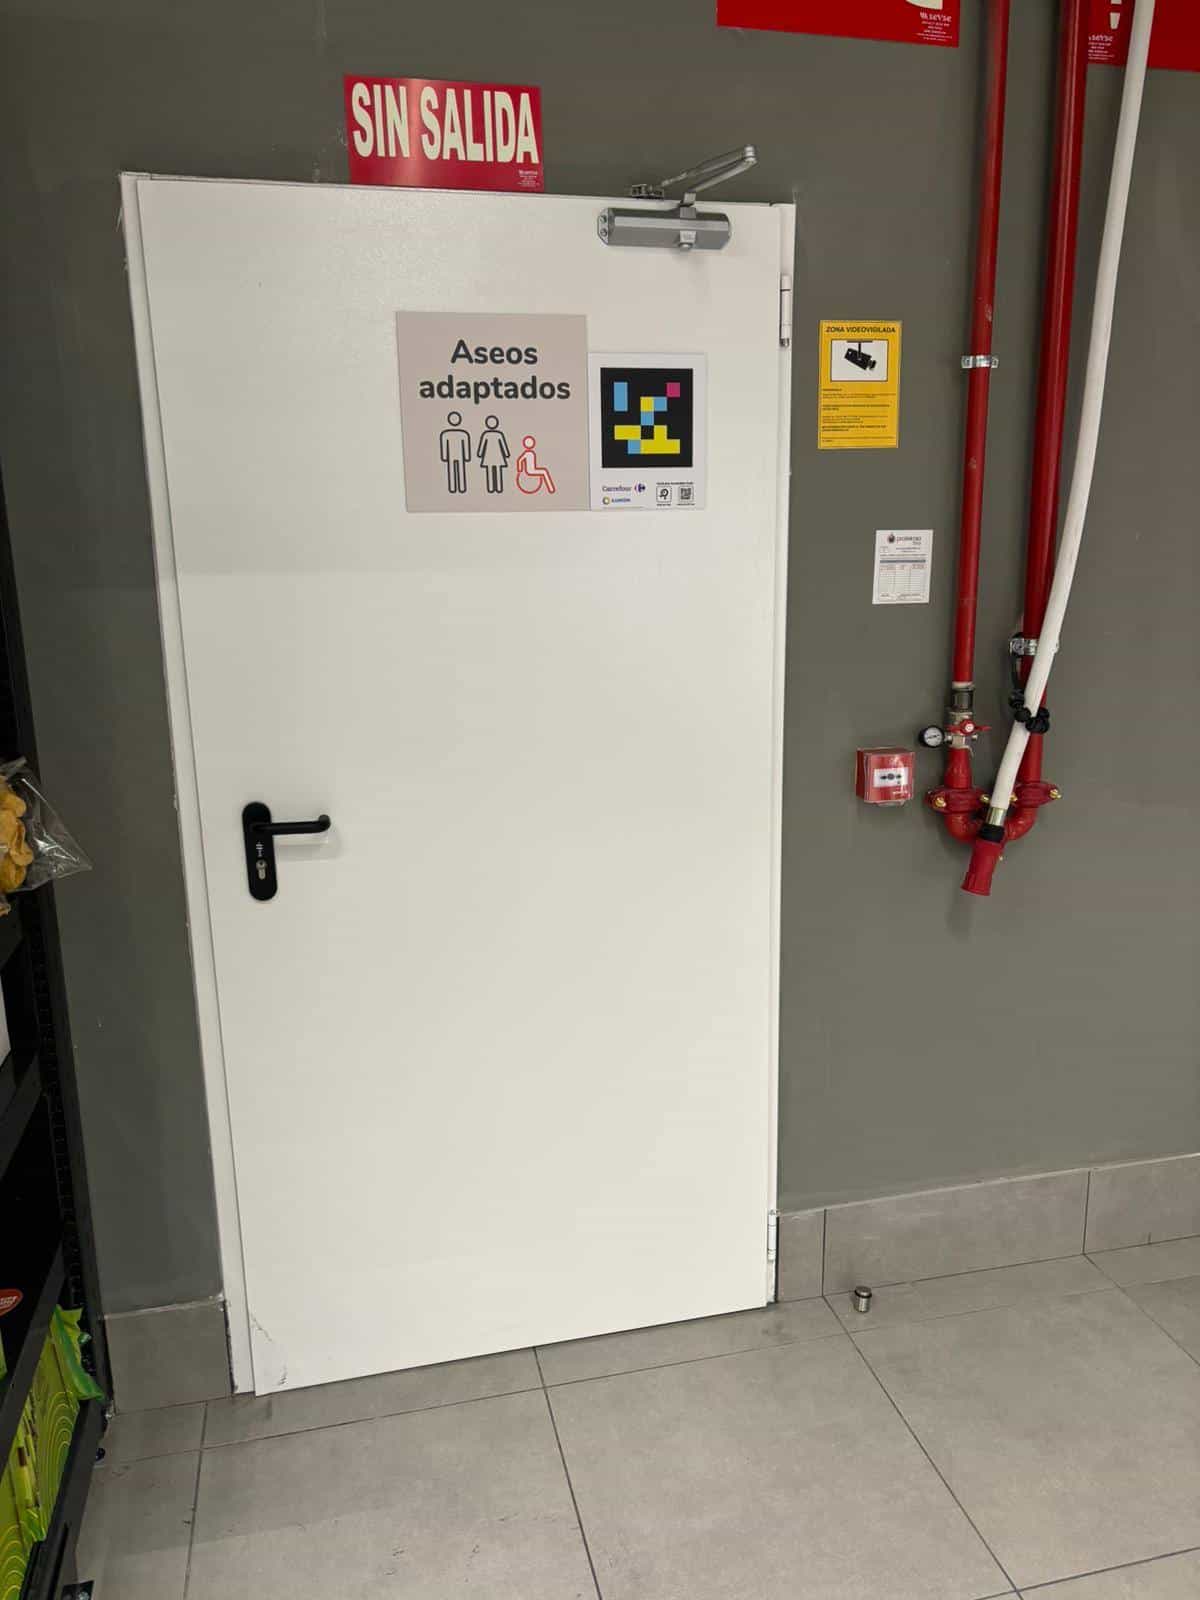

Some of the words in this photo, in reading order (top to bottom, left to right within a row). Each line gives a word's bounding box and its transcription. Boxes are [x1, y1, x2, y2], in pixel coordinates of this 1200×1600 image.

[351, 82, 410, 158] SIN
[420, 86, 540, 164] SALIDA
[846, 326, 896, 334] VIDEOVIGILADA
[451, 339, 538, 365] Aseos
[419, 374, 571, 405] adaptados
